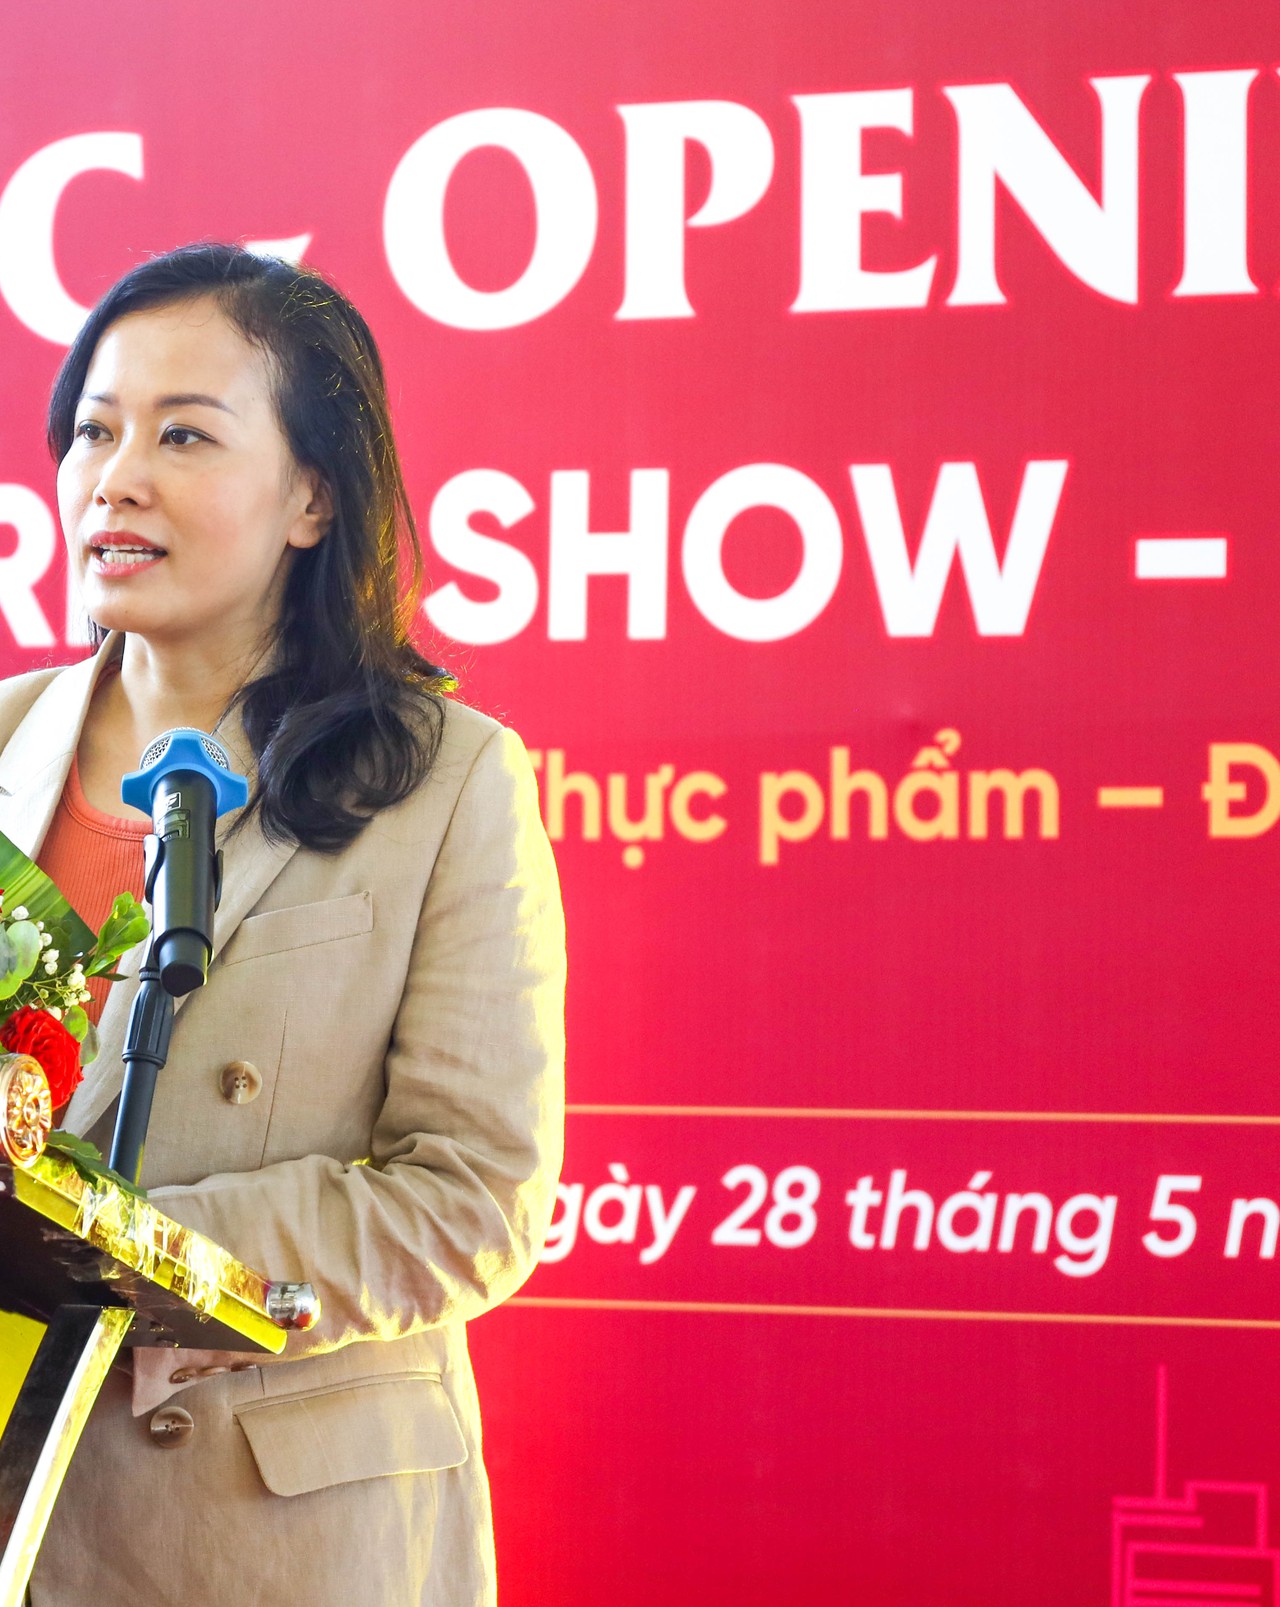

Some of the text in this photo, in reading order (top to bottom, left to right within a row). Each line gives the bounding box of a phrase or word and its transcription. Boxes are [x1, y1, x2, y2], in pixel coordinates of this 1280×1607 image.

[381, 67, 1280, 331] OPENI
[422, 460, 1069, 646] SHOW
[1135, 538, 1228, 579] -
[524, 749, 727, 870] hực
[760, 728, 1060, 866] phẩm
[711, 1164, 821, 1249] 28
[845, 1169, 1118, 1278] tháng
[1142, 1174, 1202, 1258] 5
